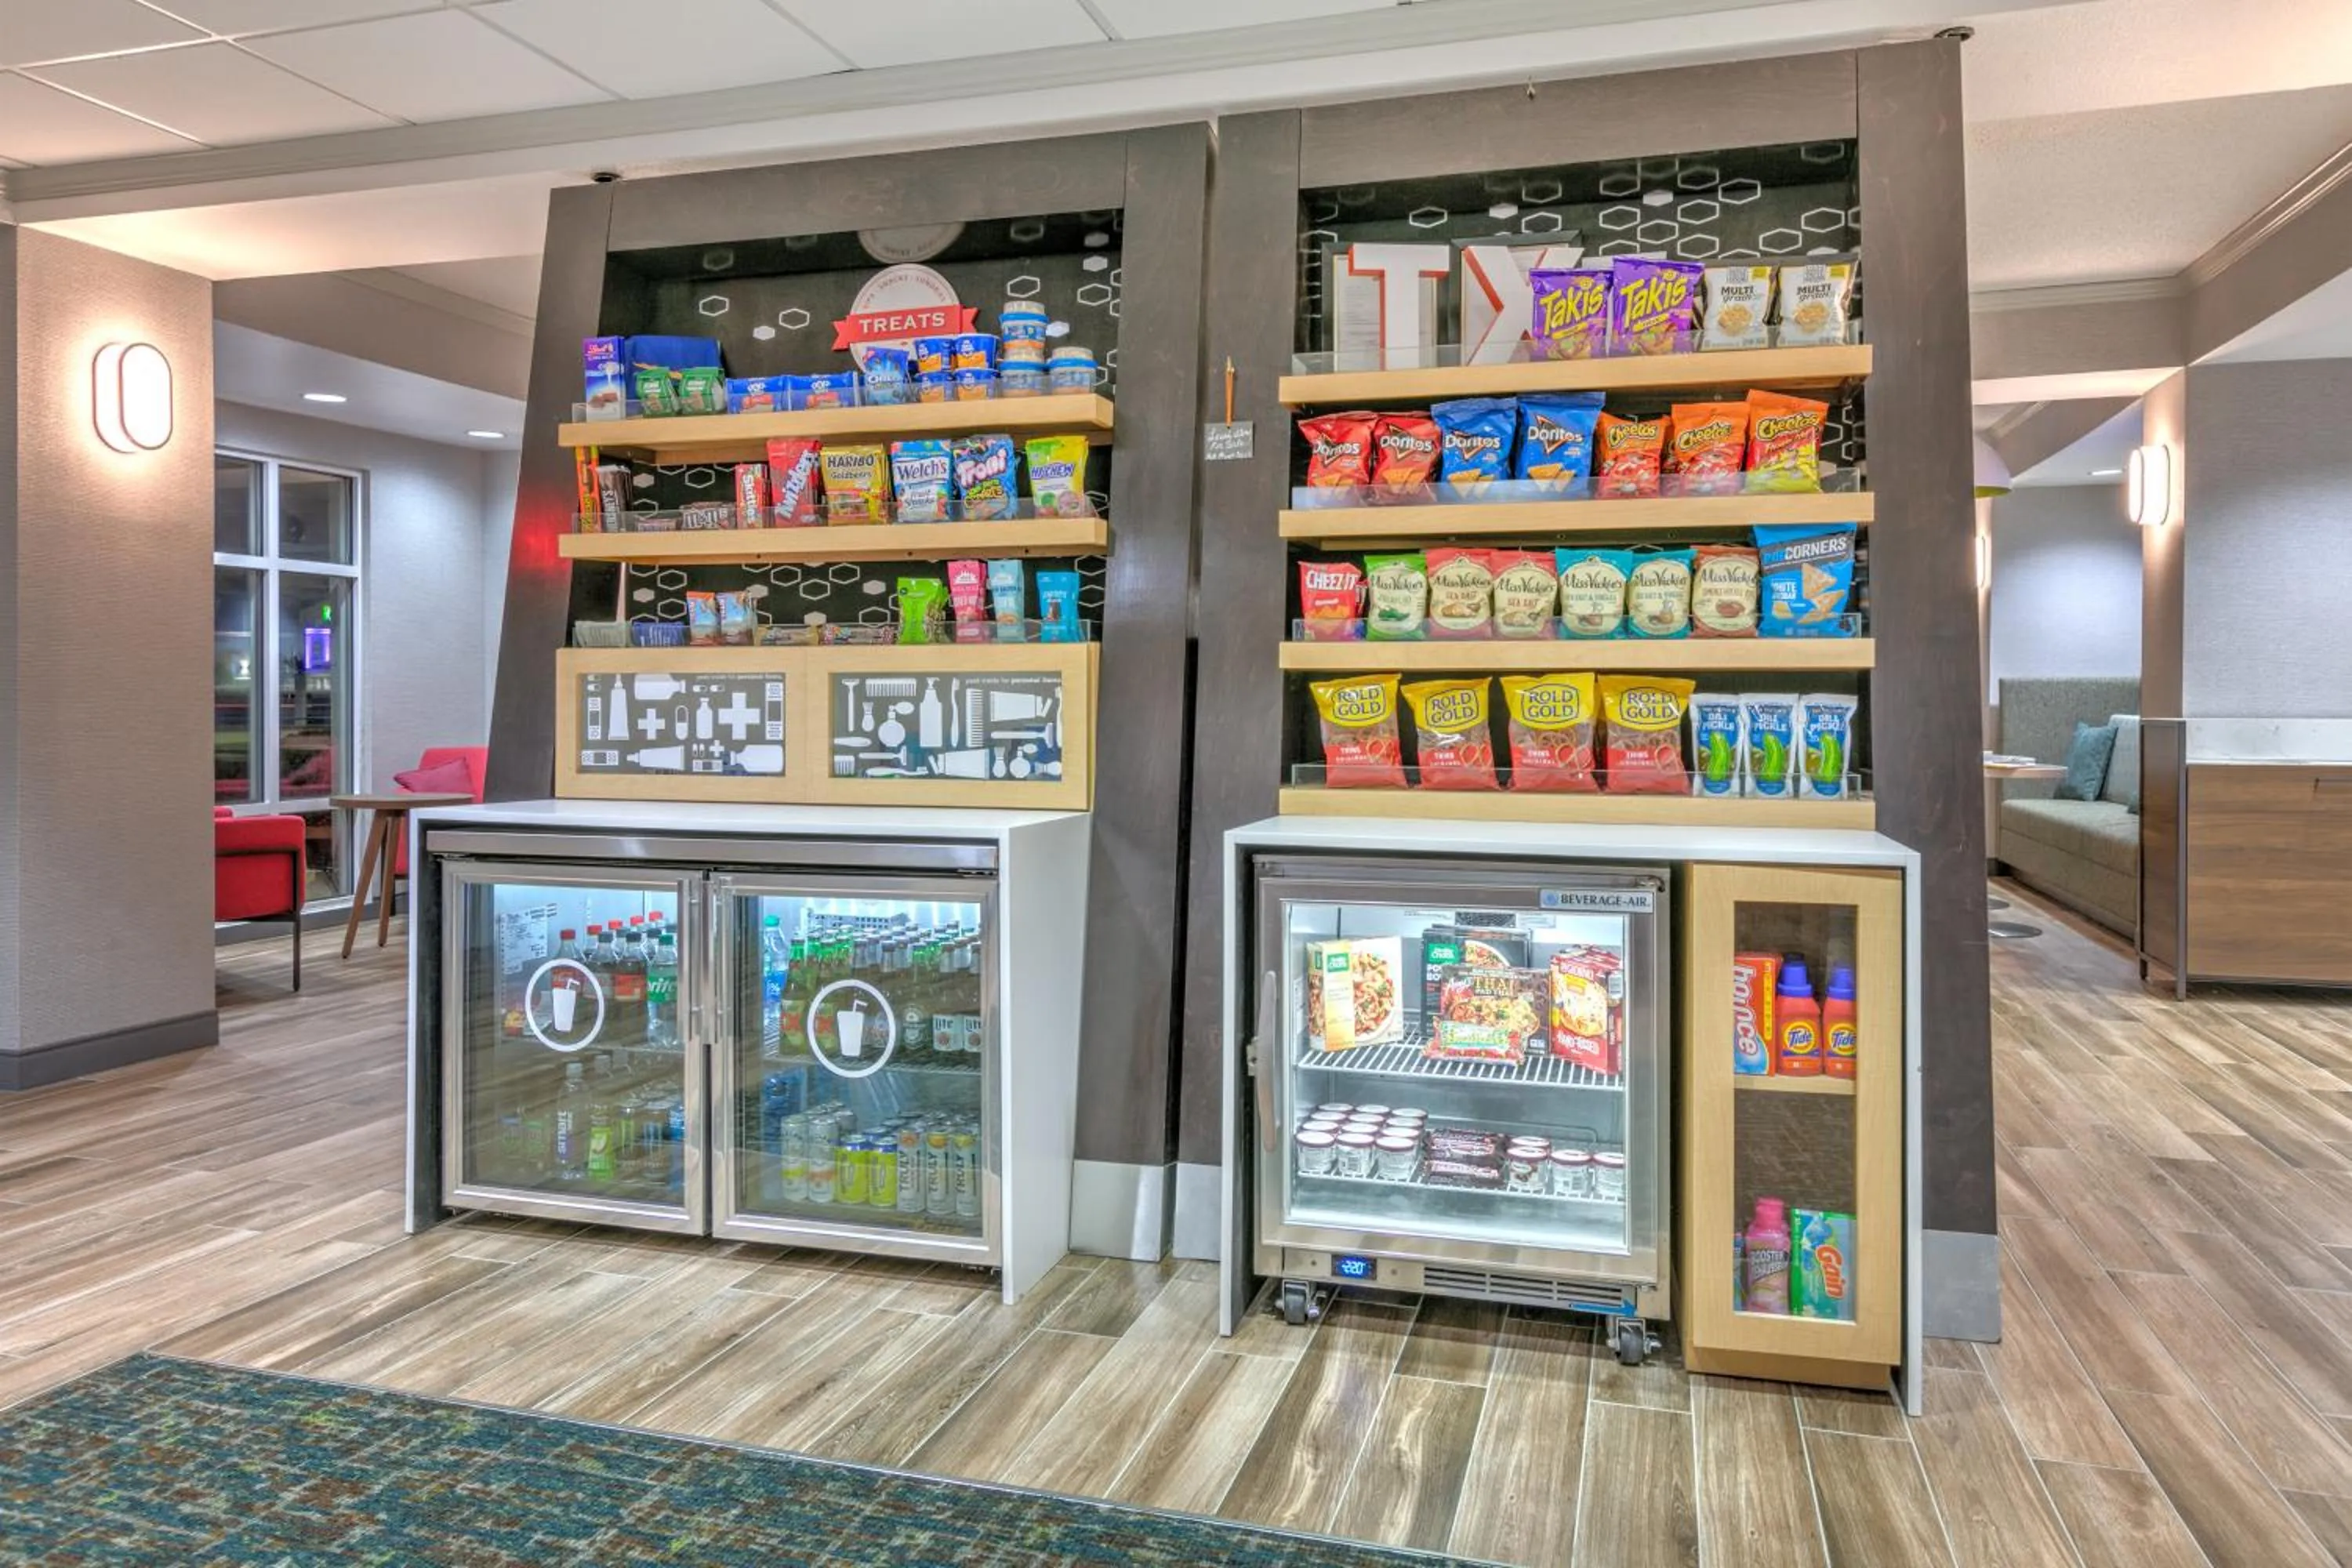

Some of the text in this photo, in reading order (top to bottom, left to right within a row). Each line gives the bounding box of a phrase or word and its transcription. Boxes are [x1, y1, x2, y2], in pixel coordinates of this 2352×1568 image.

[1721, 285, 1755, 296] MULTI
[1797, 283, 1831, 296] MULTI
[1540, 284, 1604, 336] Takis
[1621, 276, 1688, 328] Takis
[858, 312, 946, 334] TREATS
[1528, 425, 1583, 443] Doritos
[1759, 413, 1819, 439] Cheetos
[1381, 434, 1433, 452] Doritos
[1445, 434, 1500, 449] Doritos
[1609, 423, 1657, 447] Cheetos
[1678, 423, 1731, 450] Cheetos
[1312, 440, 1360, 456] Doritos
[826, 454, 875, 470] HARIBO
[896, 459, 948, 480] Welch's
[956, 448, 1007, 488] Trolli
[1338, 687, 1380, 702] ROLD
[1530, 691, 1573, 704] ROLD
[1627, 692, 1671, 705] ROLD
[1338, 704, 1381, 717] GOLD
[1432, 695, 1472, 712] ROLD
[1529, 705, 1574, 718] GOLD
[1430, 709, 1474, 724] GOLD
[1627, 706, 1675, 719] GOLD
[1561, 893, 1649, 906] BEVERAGE-AIR
